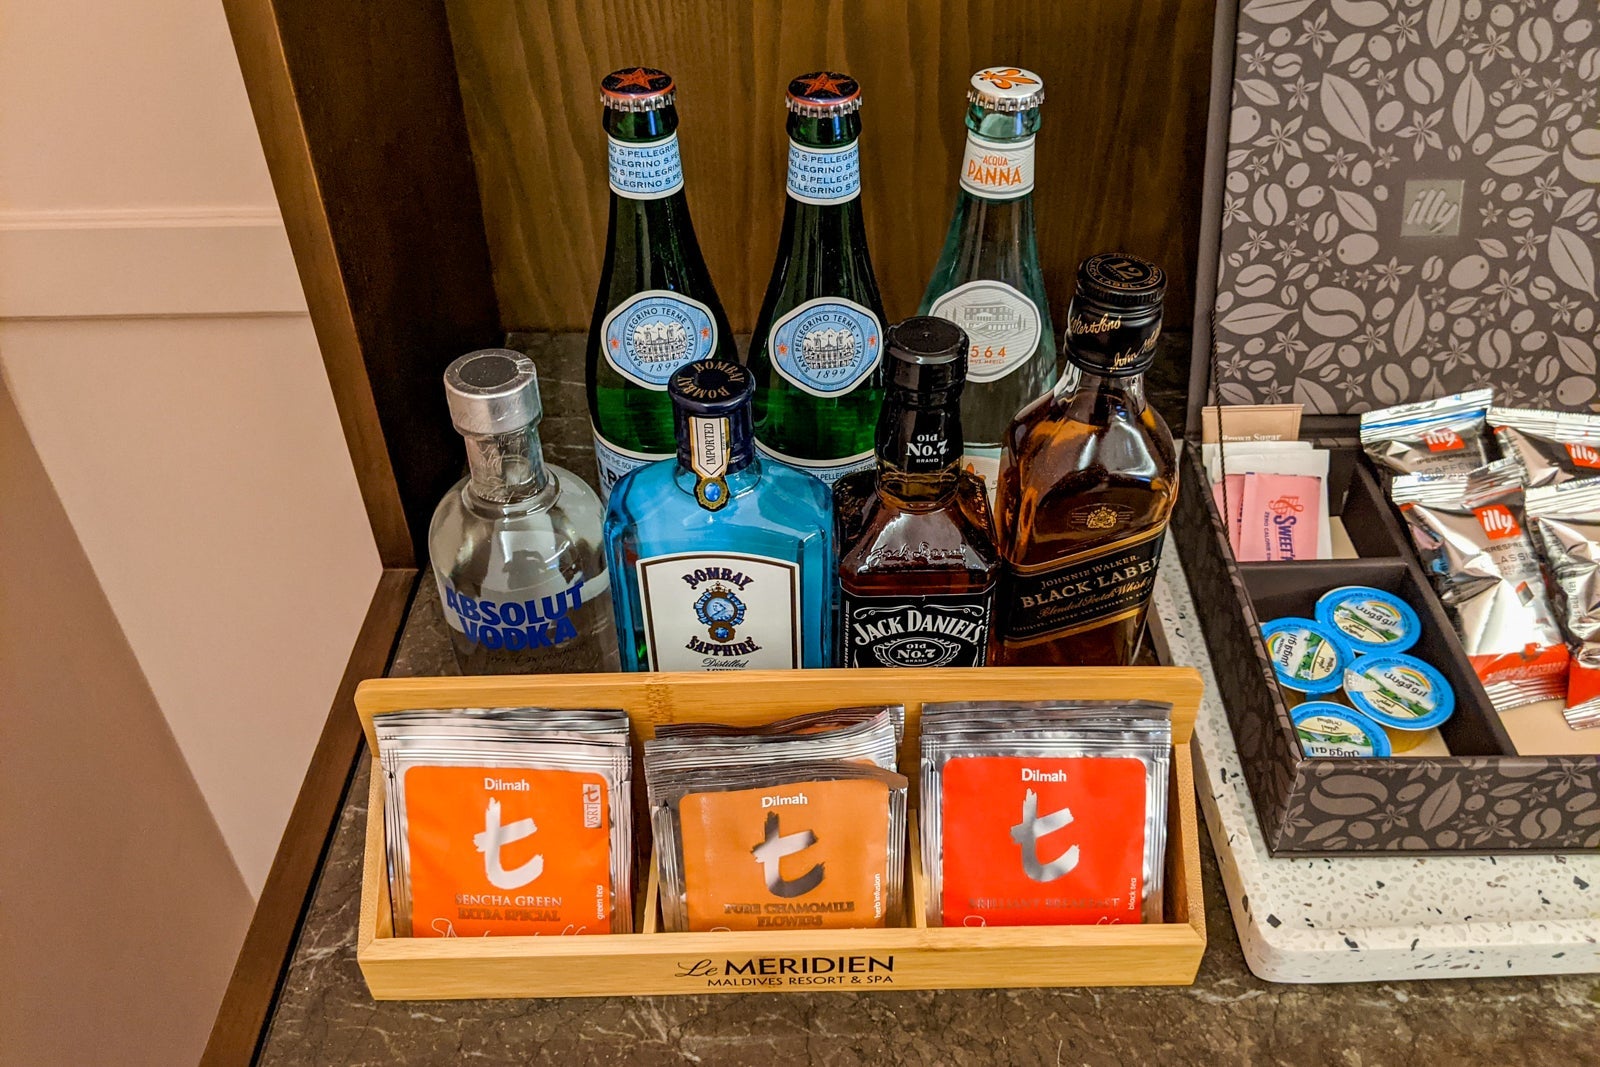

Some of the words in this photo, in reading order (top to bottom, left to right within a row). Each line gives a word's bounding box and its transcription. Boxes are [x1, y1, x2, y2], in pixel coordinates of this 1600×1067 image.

[983, 155, 1008, 166] ACQUA
[967, 159, 1022, 186] PANNA
[1404, 188, 1459, 233] illy
[661, 307, 688, 324] TERME
[833, 314, 857, 331] TERME
[626, 307, 658, 346] PELLEGRINO
[795, 314, 830, 353] PELLEGRINO
[682, 334, 694, 360] ITALIA
[849, 341, 862, 368] ITALIA
[628, 349, 643, 367] SAN
[649, 361, 680, 373] 1899
[797, 354, 811, 374] SAN
[692, 360, 745, 384] BOMBAY
[815, 368, 846, 380] 1899
[703, 422, 716, 465] IMPORTED
[905, 439, 948, 457] No.7
[1570, 443, 1599, 465] illy
[1482, 509, 1515, 535] illy
[681, 566, 754, 591] BOMBAY
[1020, 580, 1093, 609] BLACK
[1096, 555, 1160, 588] LABEL
[1041, 569, 1090, 590] JOHNNIE
[1092, 554, 1137, 574] WALKER
[445, 581, 584, 627] ABSOLUT
[458, 615, 578, 652] VODKA
[853, 616, 905, 646] JACK
[906, 609, 985, 646] DANIEL'S
[685, 635, 761, 657] SAPPHIRE
[896, 648, 937, 659] No.7
[701, 657, 749, 668] Distilled
[484, 777, 530, 791] Dilmah
[1021, 768, 1067, 782] Dilmah
[761, 793, 808, 808] Dilmah
[586, 803, 599, 827] VSRT
[455, 894, 512, 906] SENCHA
[514, 895, 562, 906] GREEN
[597, 897, 605, 920] green
[723, 902, 761, 915] PURE
[764, 901, 855, 915] CHAMOMILE
[874, 901, 882, 919] herb
[1127, 889, 1135, 910] black
[457, 907, 504, 920] EXTRA
[504, 908, 561, 922] SPECIAL
[757, 915, 823, 928] FLOWERS
[674, 958, 719, 978] Le
[724, 955, 894, 976] MERIDIEN
[707, 977, 784, 987] MALDIVES
[788, 975, 845, 985] RESORT
[850, 975, 862, 985] &
[866, 974, 894, 984] SPA
